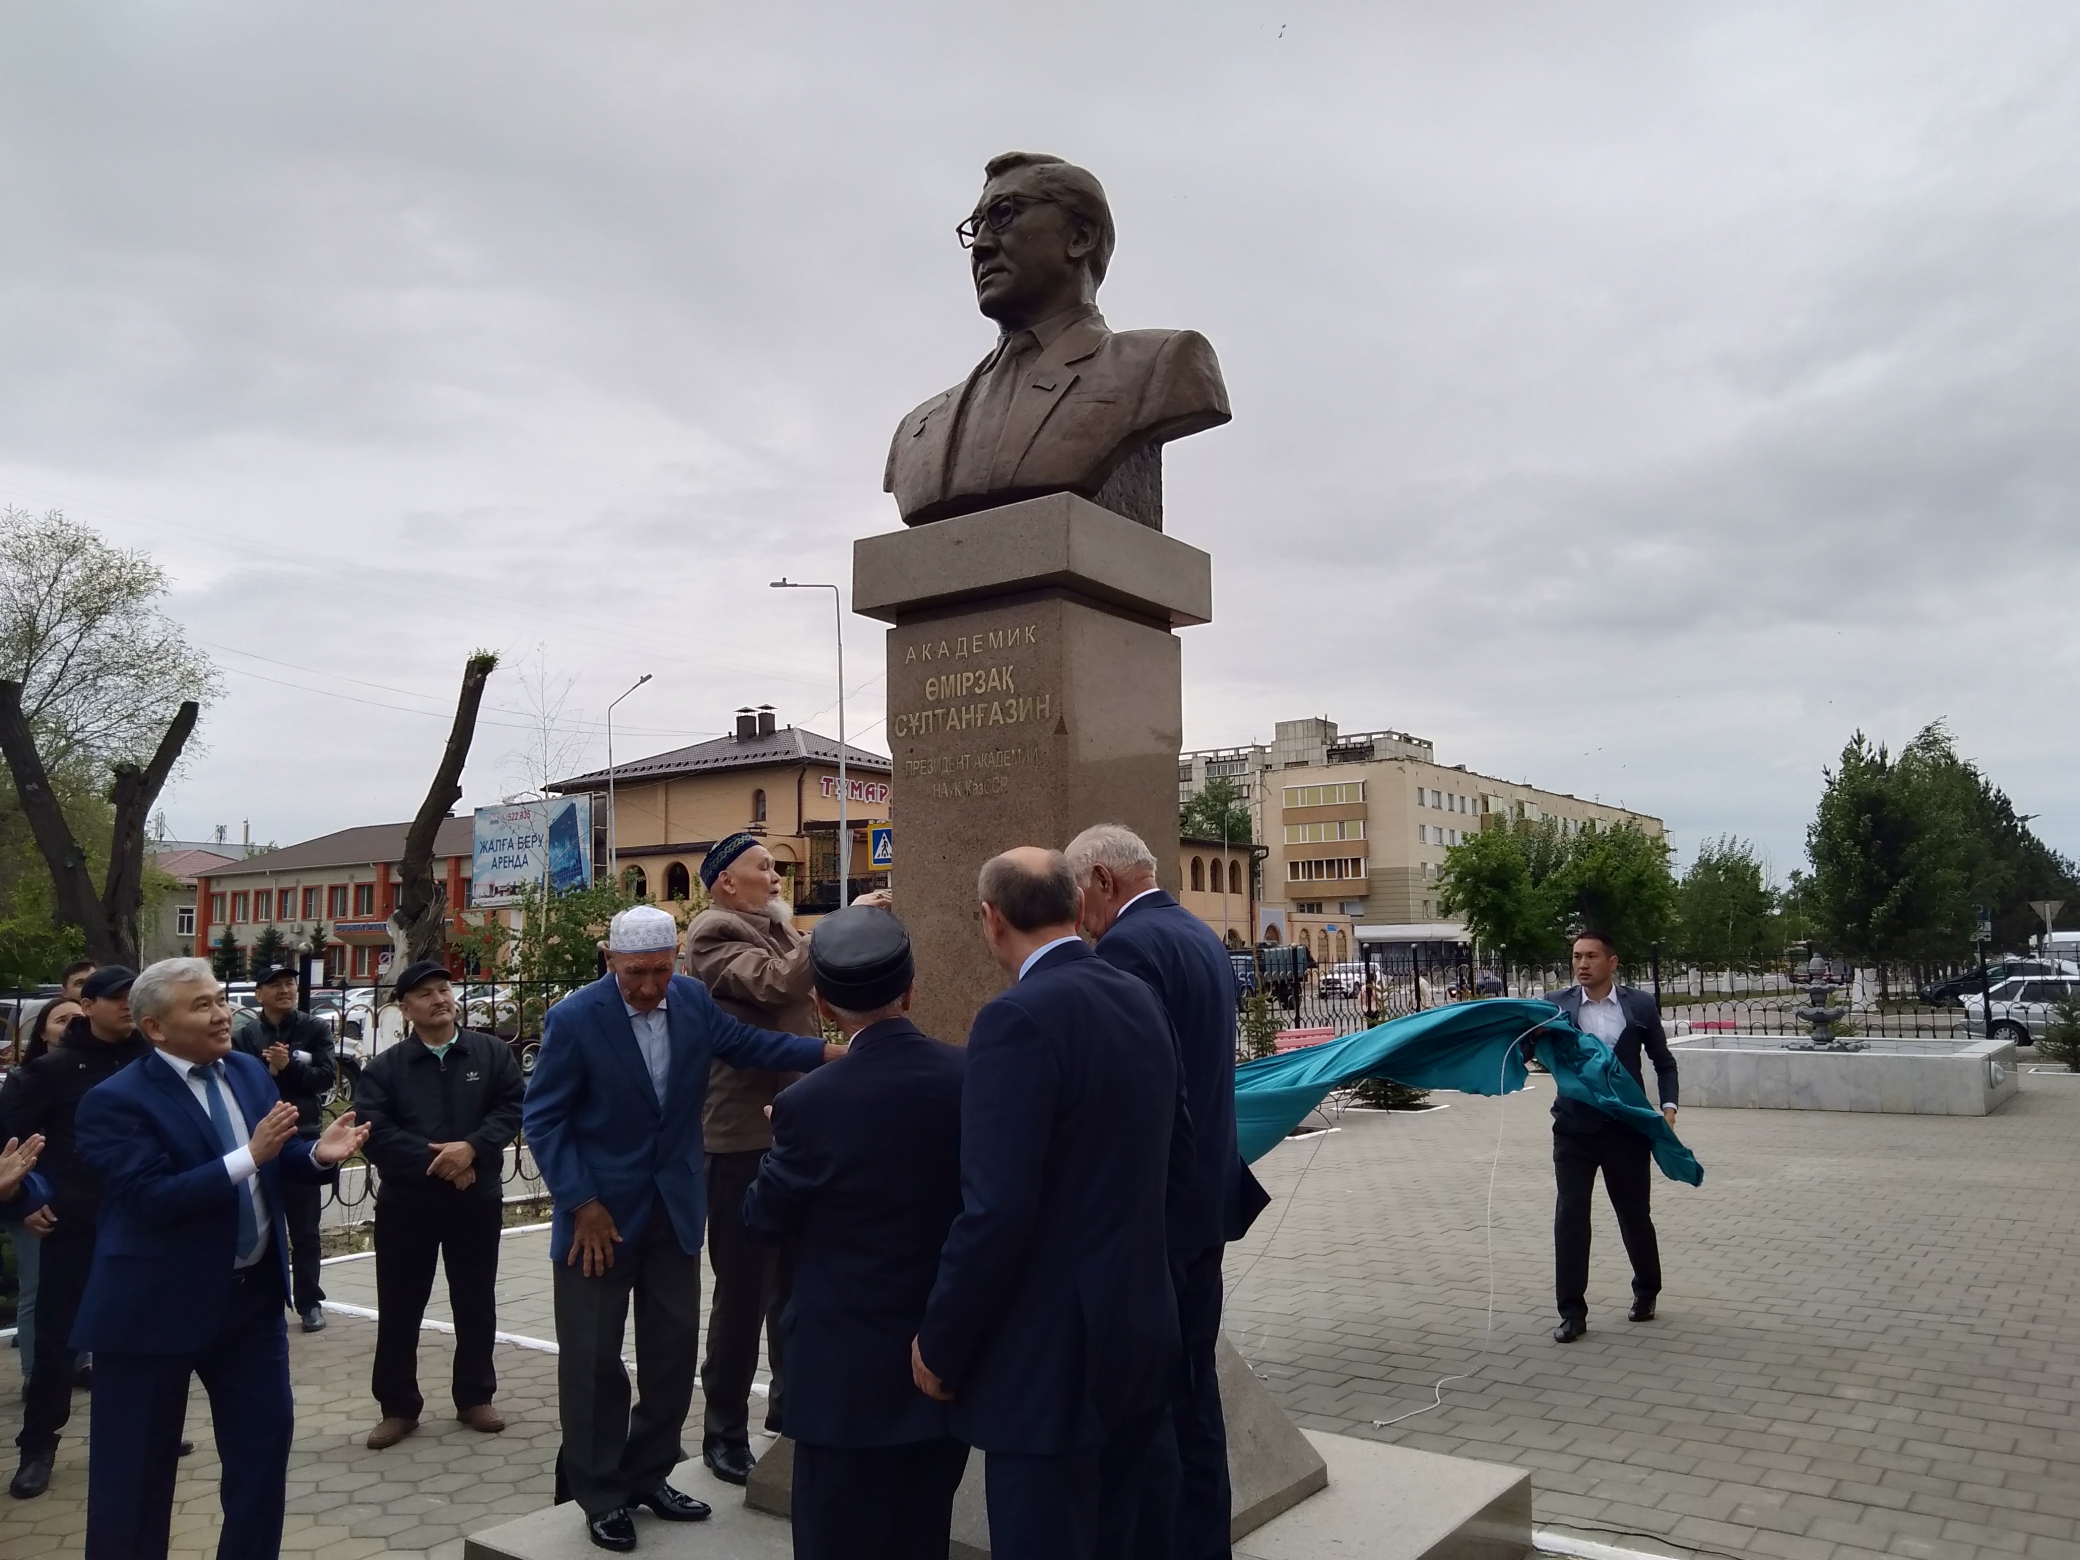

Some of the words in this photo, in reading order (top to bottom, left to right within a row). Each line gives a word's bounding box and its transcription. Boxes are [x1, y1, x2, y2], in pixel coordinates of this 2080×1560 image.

[906, 625, 1036, 665] АКАДЕМИК
[925, 665, 1015, 701] ӨМІРЗАҚ
[894, 694, 1050, 738] СҰЛТАНҒАЗИН
[905, 754, 971, 777] ПРЕЗИДЕНТ
[973, 746, 1038, 770] АКАДЕМИИ
[933, 780, 962, 798] НАУК
[479, 836, 515, 854] ЖАЛҒА
[517, 833, 544, 850] БЕРУ
[491, 853, 529, 870] АРЕНДА
